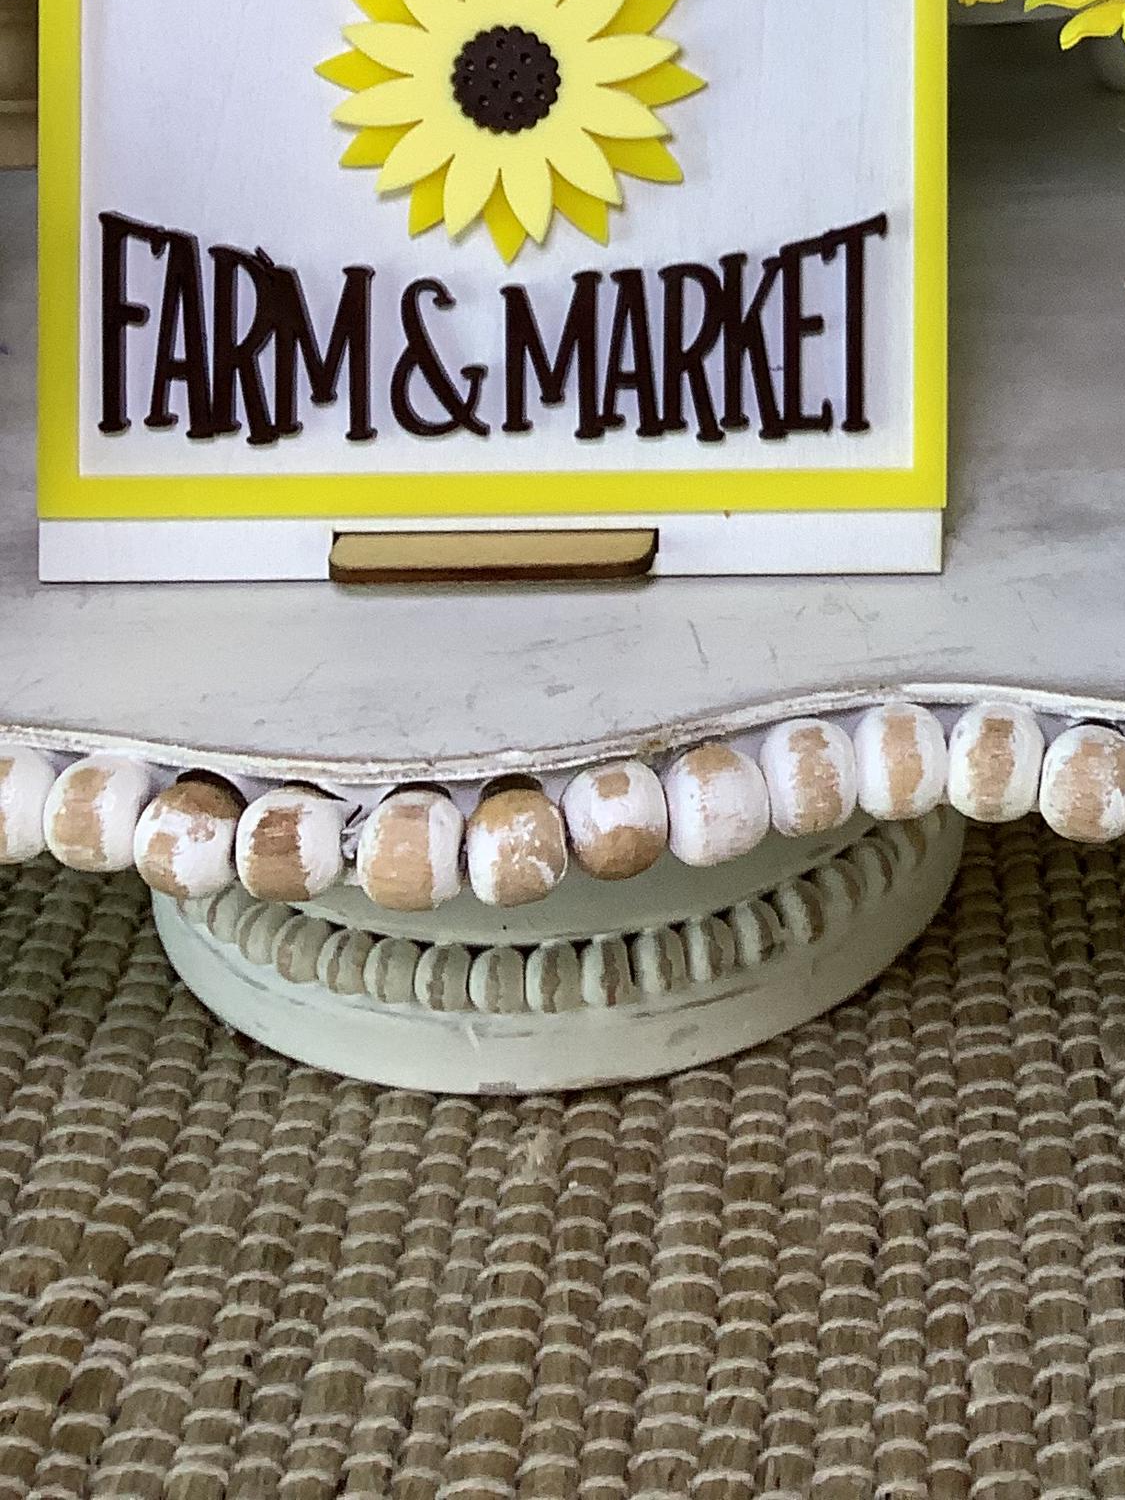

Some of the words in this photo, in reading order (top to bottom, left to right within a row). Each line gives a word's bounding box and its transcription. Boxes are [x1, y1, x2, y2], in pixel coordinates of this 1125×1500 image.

[97, 212, 377, 445] FARM
[391, 278, 490, 439] &
[502, 214, 888, 443] MARKET
